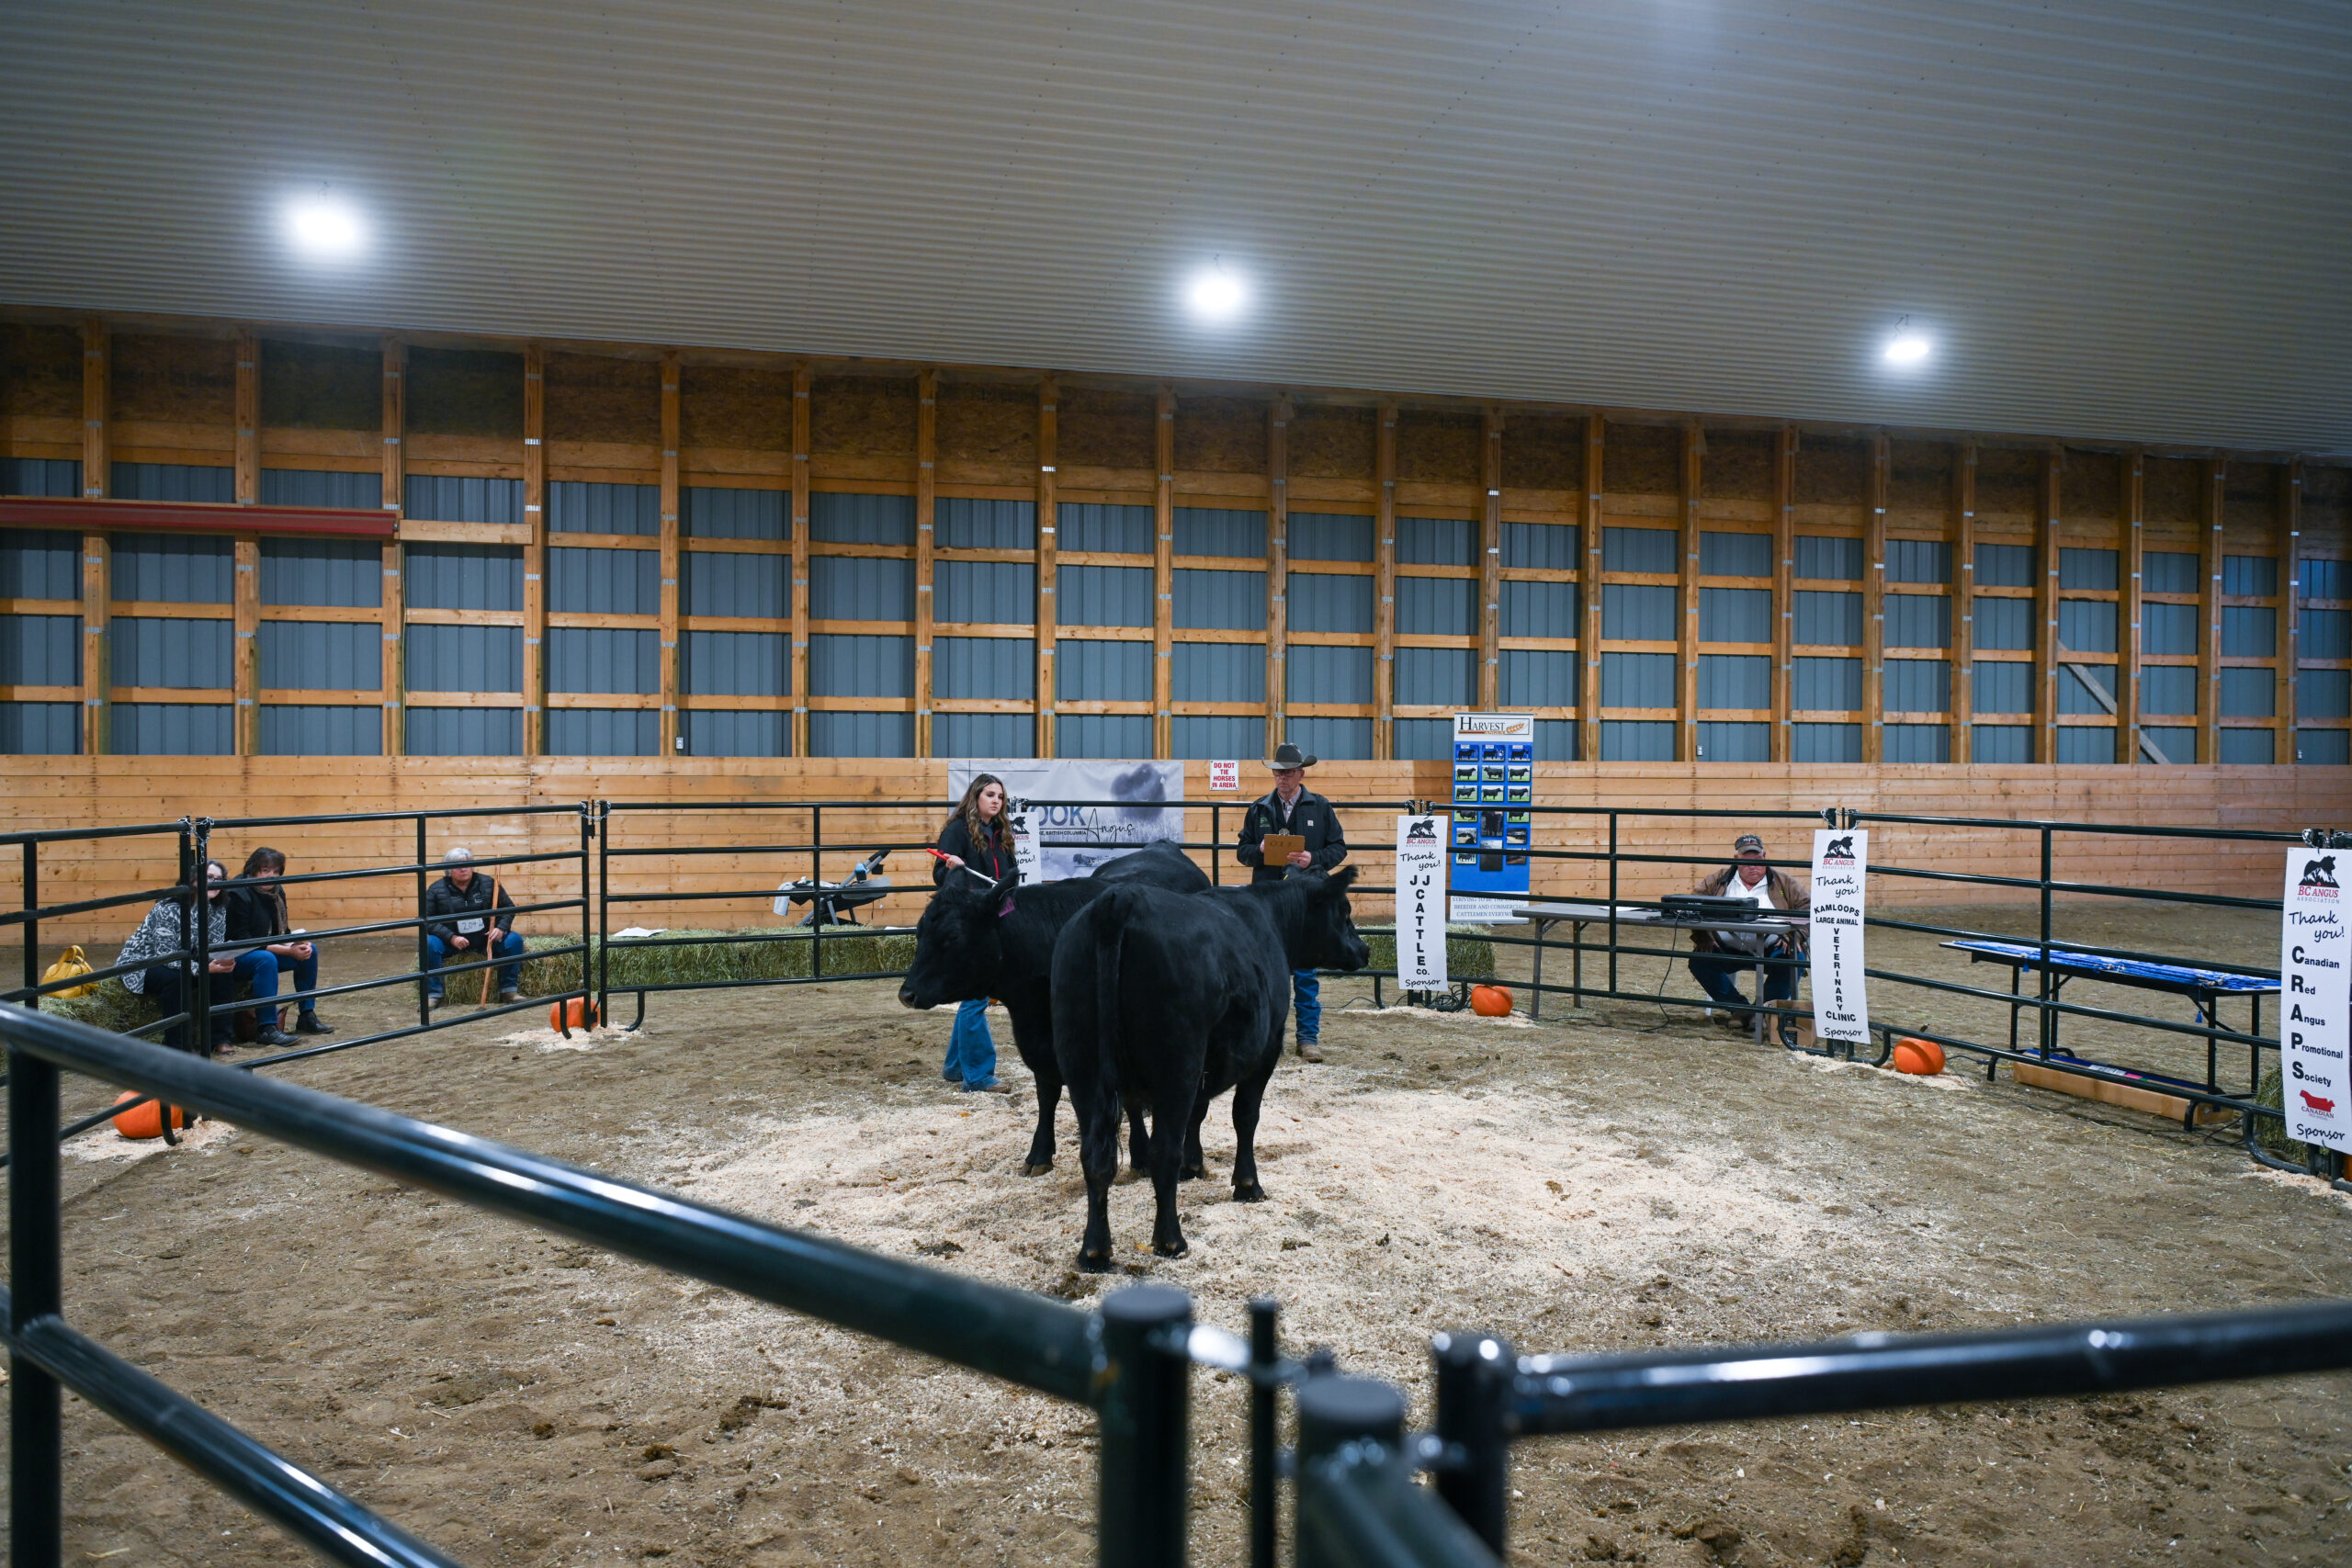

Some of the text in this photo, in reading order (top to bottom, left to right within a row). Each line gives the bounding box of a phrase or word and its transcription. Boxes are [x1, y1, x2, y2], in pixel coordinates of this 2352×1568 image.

[1460, 716, 1506, 731] HARVEST
[1086, 807, 1135, 842] Angus
[1399, 851, 1436, 862] Thank
[1823, 857, 1834, 865] BC
[1419, 859, 1441, 871] you!
[1815, 874, 1854, 886] Thank
[1835, 885, 1860, 898] you!
[2298, 886, 2339, 898] BC ANGUS
[1814, 904, 1860, 917] KAMLOOPS
[2289, 910, 2338, 925] Thank
[1415, 888, 1426, 966] CATTLE
[1836, 918, 1859, 926] ANIMAL
[2314, 926, 2345, 943] you!
[2291, 945, 2340, 969] Canadian
[1833, 928, 1843, 1010] VETERINARY
[1405, 978, 1442, 988] Sponsor
[2290, 974, 2316, 996] Red
[1826, 1010, 1856, 1021] CLINIC
[2290, 1003, 2326, 1026] Angus
[1824, 1027, 1862, 1038] Sponsor
[2290, 1032, 2343, 1059] Promotional
[2291, 1060, 2332, 1088] Society
[2301, 1105, 2335, 1119] CANADIAN
[2297, 1122, 2346, 1141] Sponsor
